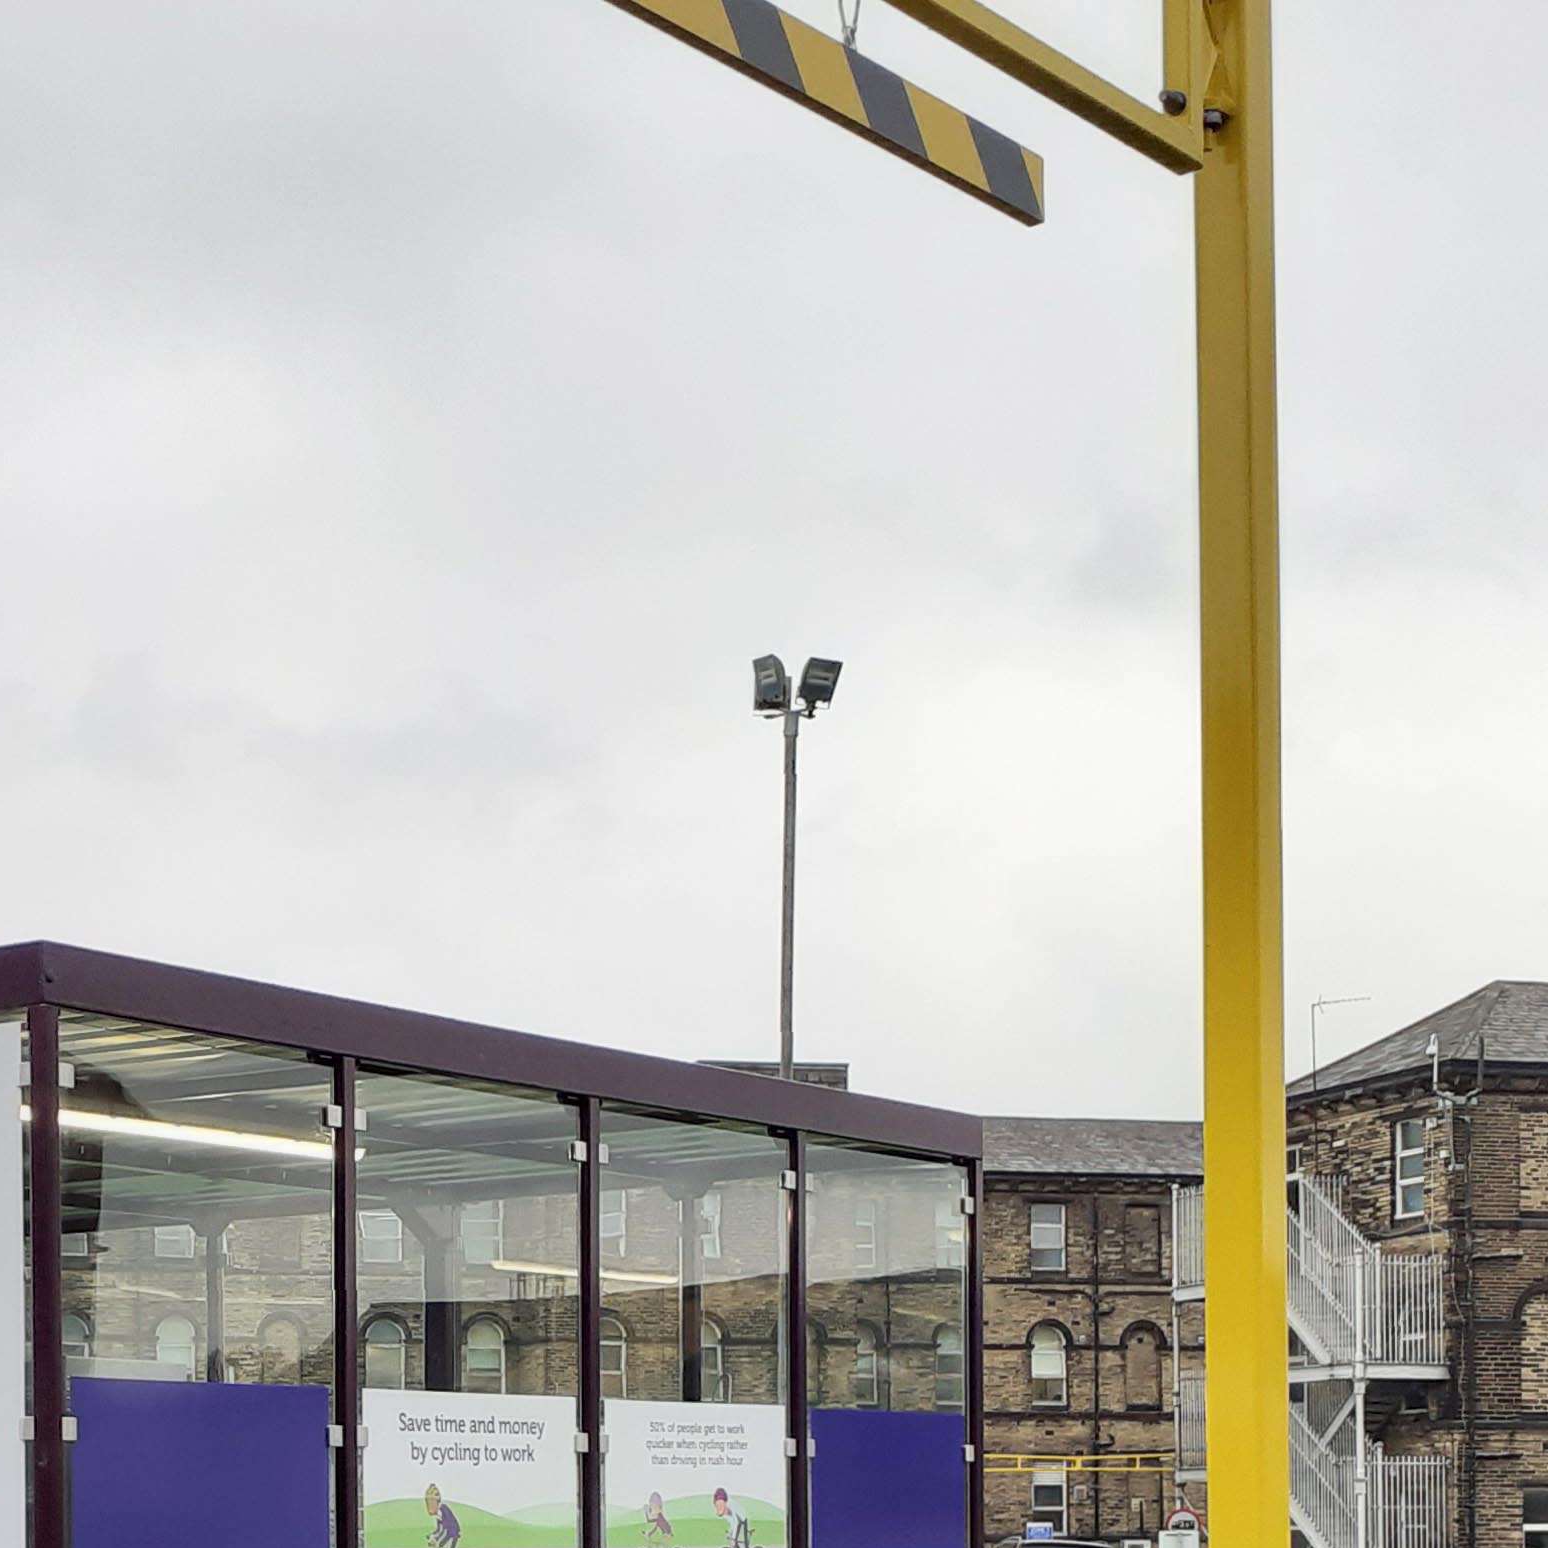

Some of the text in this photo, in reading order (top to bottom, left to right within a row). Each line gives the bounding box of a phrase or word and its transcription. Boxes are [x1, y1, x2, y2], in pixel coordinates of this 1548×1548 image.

[398, 1413, 545, 1440] Save time and money
[667, 1422, 675, 1432] of
[676, 1422, 702, 1436] people
[704, 1424, 716, 1436] get
[717, 1424, 725, 1434] to
[726, 1424, 745, 1434] work
[645, 1438, 674, 1451] quicker
[676, 1439, 698, 1449] when
[699, 1439, 725, 1452] cycling
[410, 1442, 535, 1466] by cycling to work
[652, 1454, 669, 1465] than
[671, 1454, 697, 1468] driving
